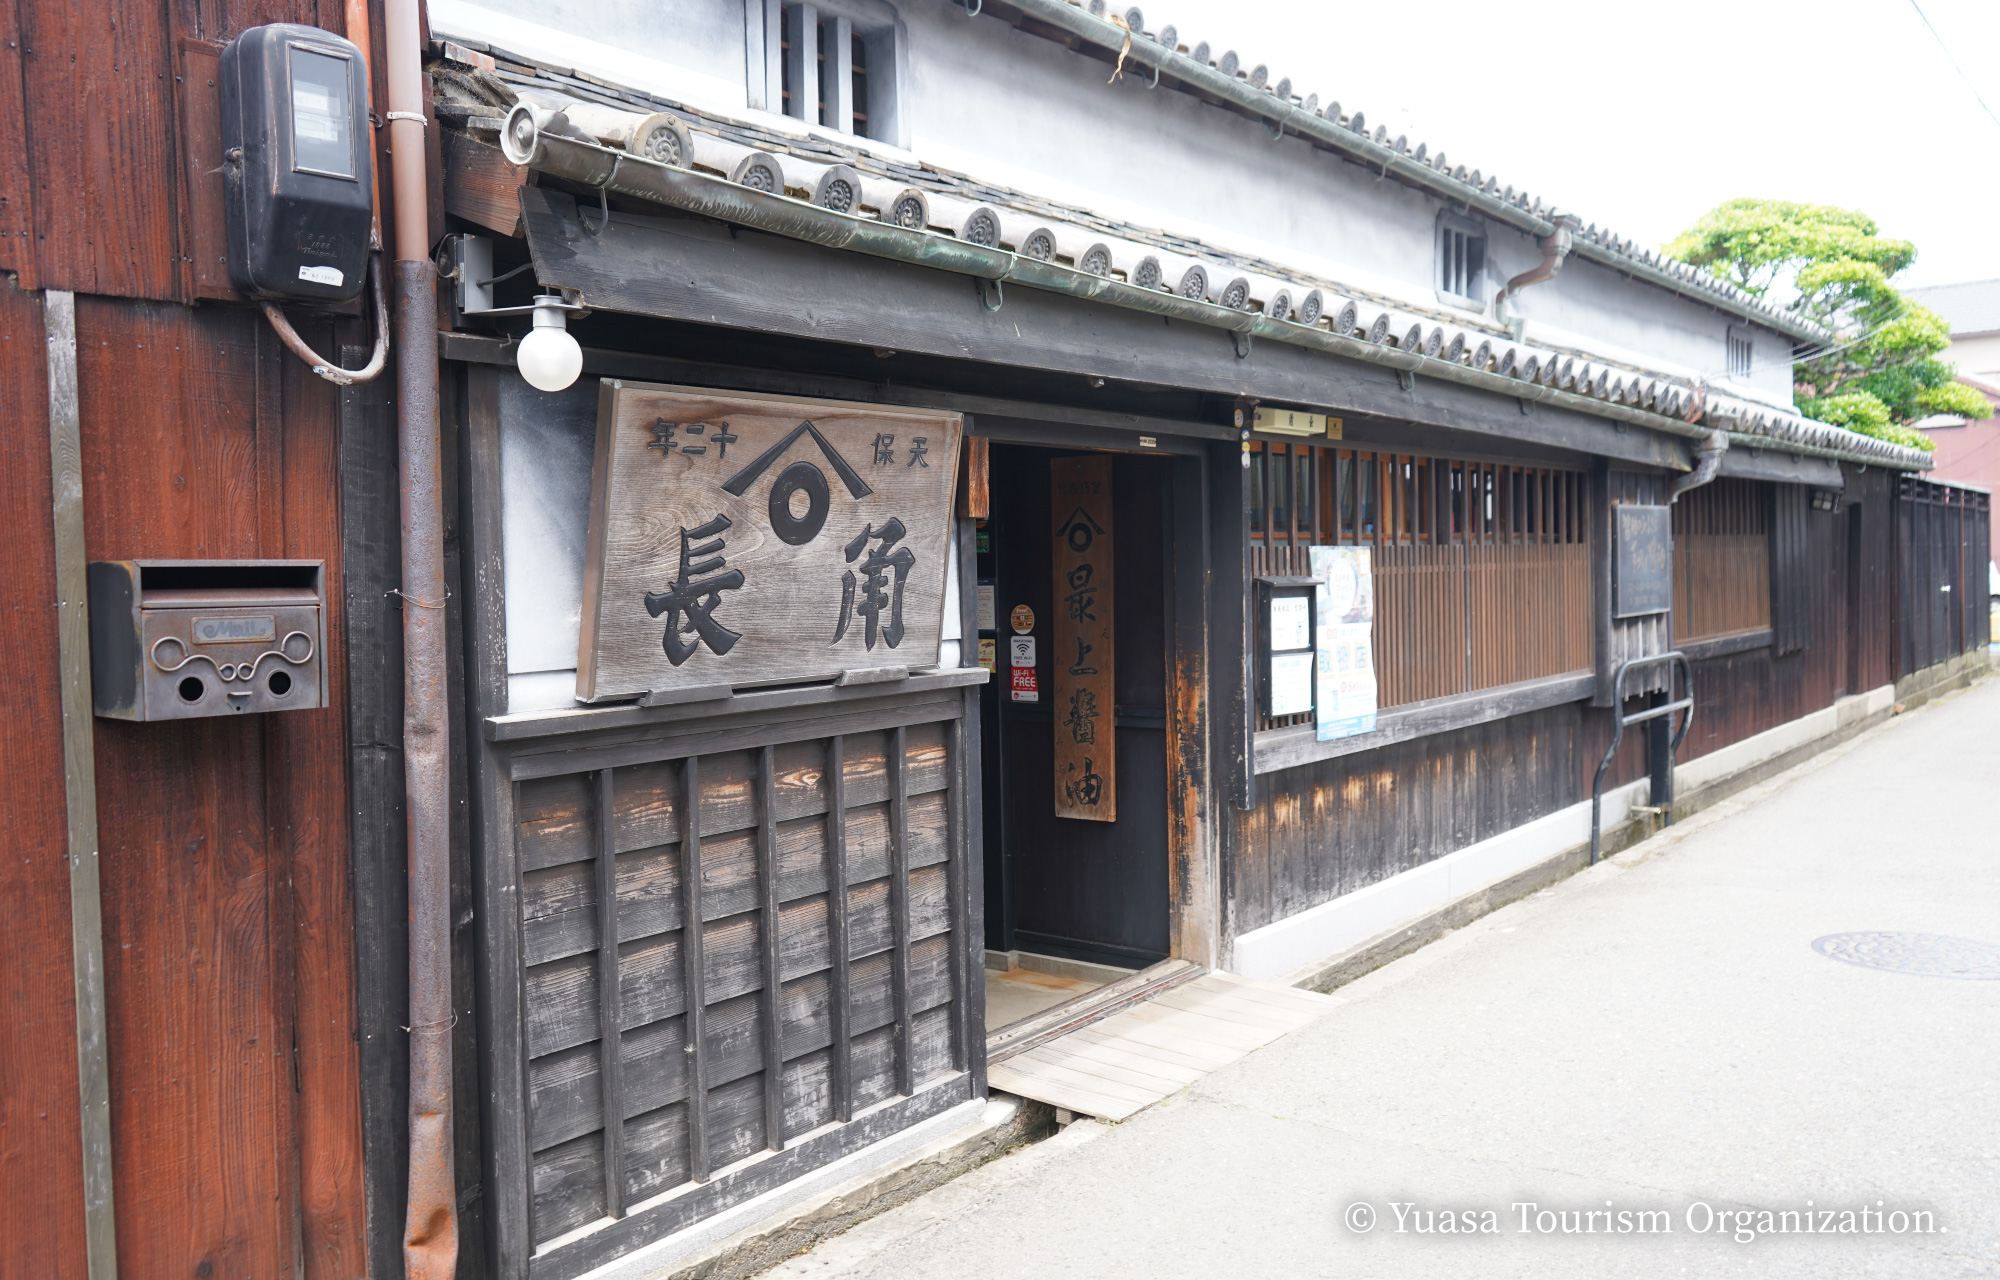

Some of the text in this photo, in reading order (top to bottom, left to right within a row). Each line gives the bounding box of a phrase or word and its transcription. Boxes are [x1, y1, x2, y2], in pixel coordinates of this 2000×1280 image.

[203, 620, 266, 639] Mail
[1316, 645, 1366, 673] 取扱店
[1013, 676, 1036, 687] FREE
